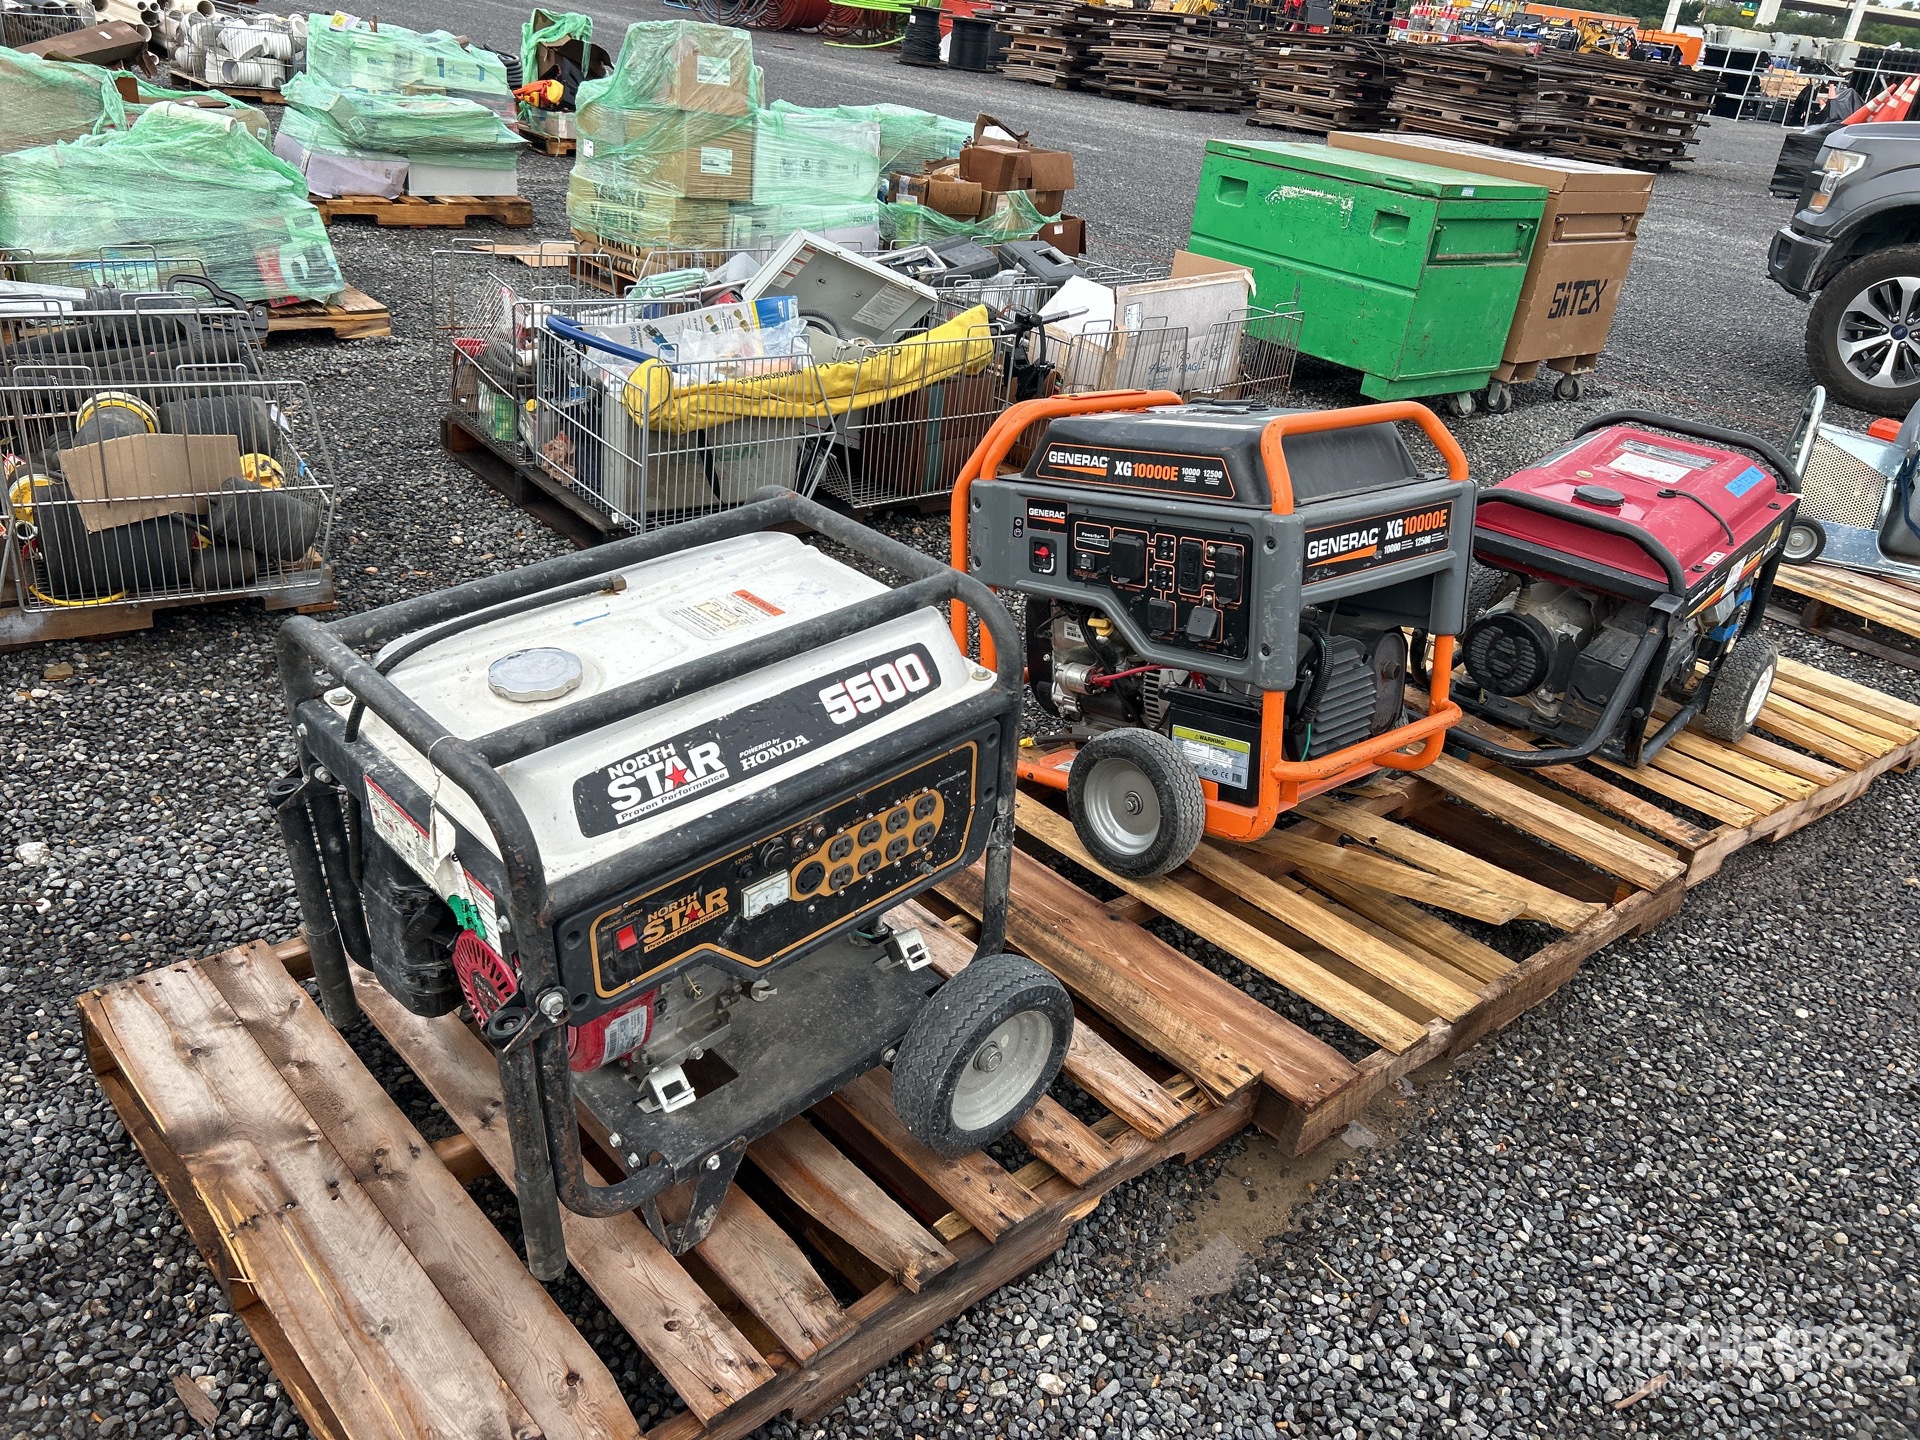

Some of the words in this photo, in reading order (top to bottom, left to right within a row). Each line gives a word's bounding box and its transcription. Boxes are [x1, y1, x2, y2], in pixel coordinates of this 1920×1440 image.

[1048, 451, 1109, 468] GENERAC
[1114, 460, 1179, 482] XG10000E
[1181, 467, 1201, 478] 10000
[1202, 469, 1223, 479] 12500
[1028, 507, 1066, 519] GENERAC
[1307, 526, 1379, 560] GENERAC
[1384, 508, 1448, 541] XG10000E
[1383, 542, 1401, 555] 10000
[1414, 534, 1432, 547] 12500
[818, 652, 931, 726] 5500
[607, 742, 677, 780] NORTH
[738, 738, 772, 759] POWERED
[771, 737, 781, 746] by
[739, 734, 810, 772] HONDA
[607, 741, 726, 811] STAR
[621, 801, 659, 821] Proven
[660, 772, 726, 804] Performance
[643, 886, 729, 944] STAR
[647, 891, 698, 922] NORTH
[646, 934, 675, 951] Proven
[676, 908, 727, 936] Performance
